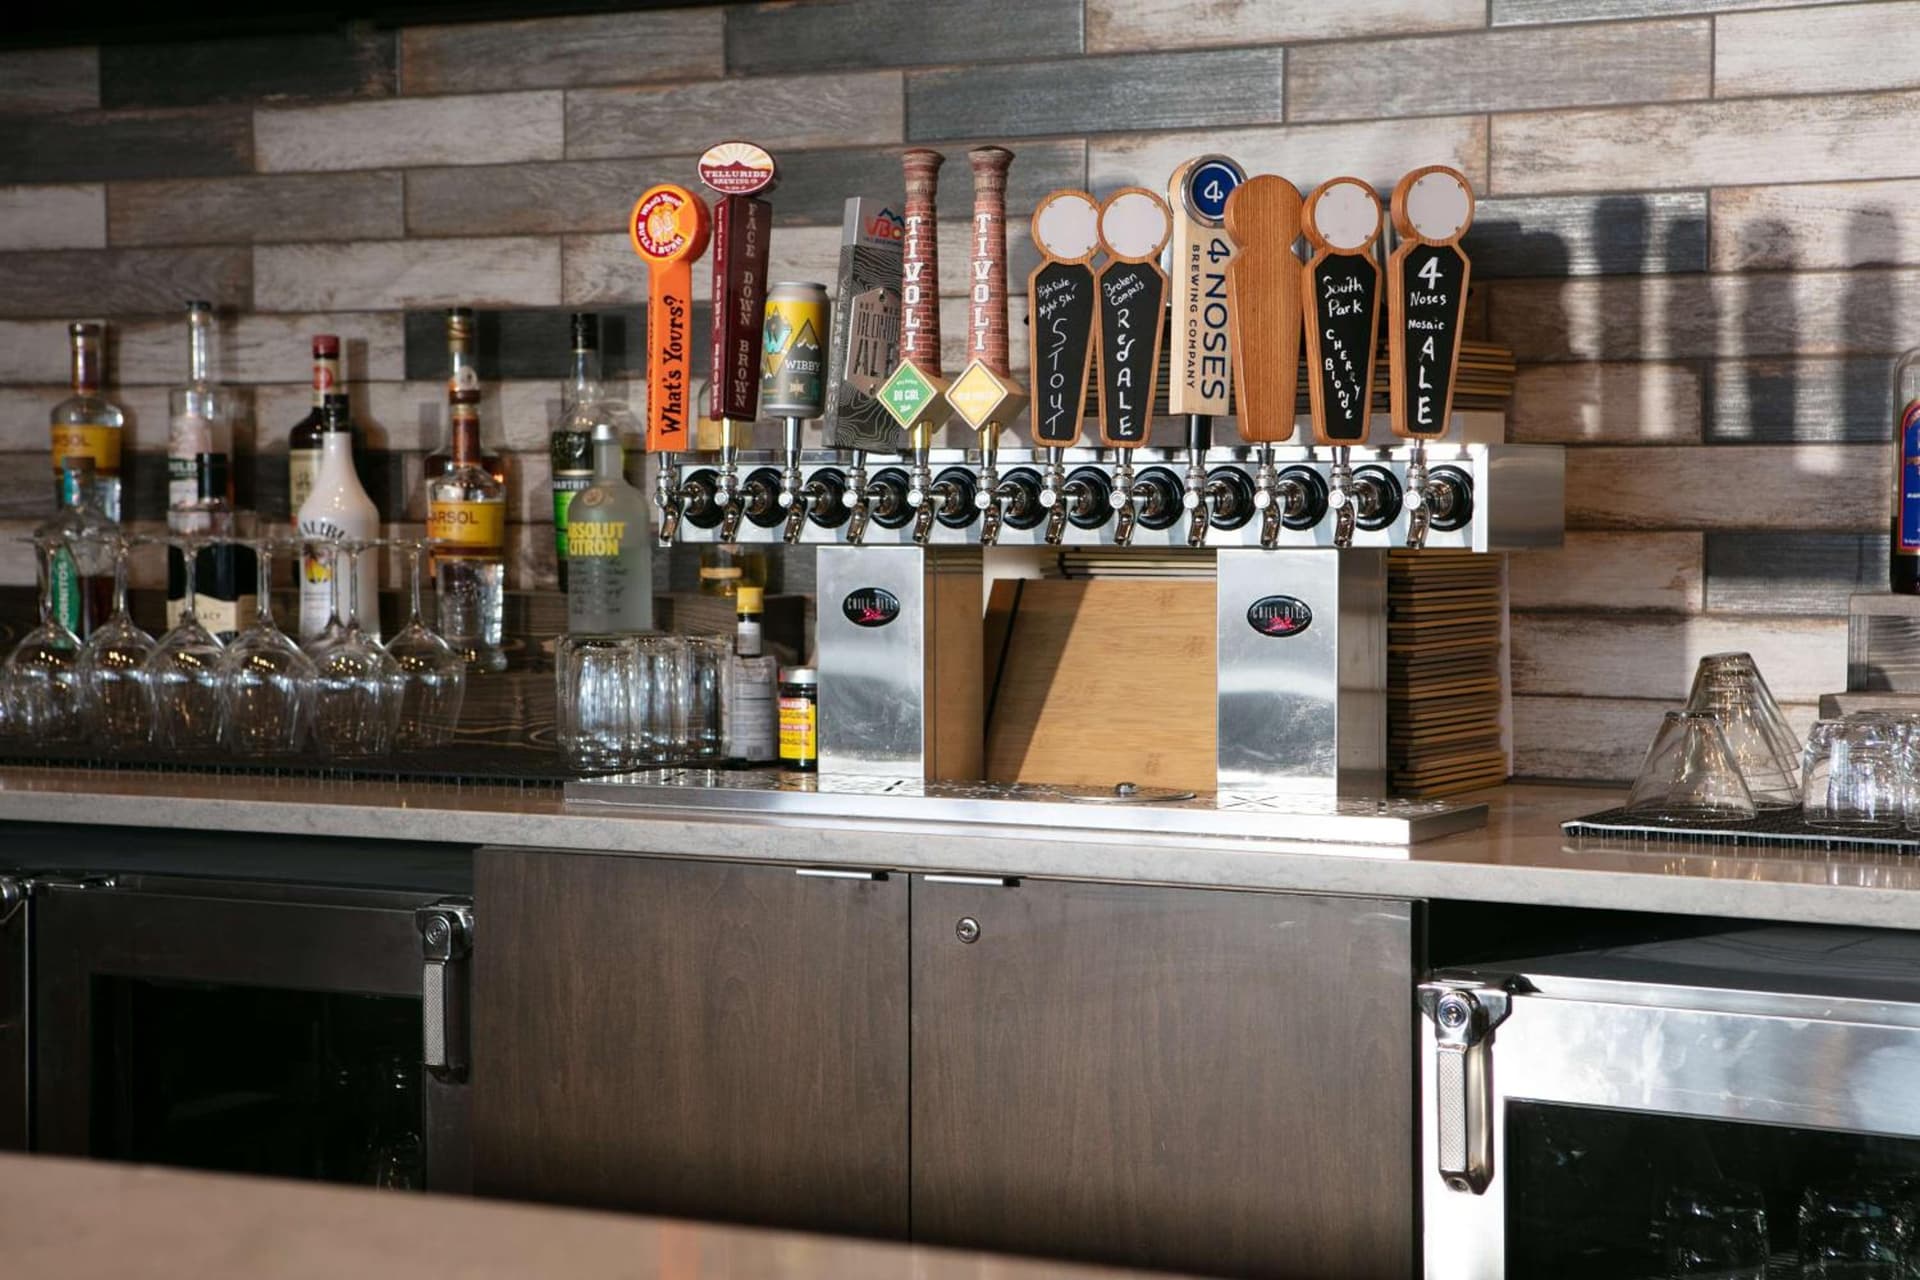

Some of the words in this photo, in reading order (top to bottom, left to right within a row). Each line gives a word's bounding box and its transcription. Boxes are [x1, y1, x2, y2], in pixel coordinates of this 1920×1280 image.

[703, 170, 769, 178] TELLURIDE
[1203, 179, 1225, 203] 4
[1189, 244, 1200, 314] BREWING
[1206, 237, 1231, 265] 4
[1417, 256, 1443, 290] 4
[740, 270, 755, 326] DOWN
[904, 215, 924, 352] TIVOLI
[972, 213, 994, 351] TIVOLI
[1103, 273, 1138, 297] Broken
[1111, 281, 1145, 306] Compass
[1323, 275, 1364, 299] South
[1328, 299, 1363, 318] Park
[1409, 291, 1447, 306] Noses
[663, 294, 684, 367] Yours?
[1201, 273, 1229, 400] NOSES
[1408, 318, 1446, 331] Mosaic
[734, 339, 750, 408] BROWN
[785, 359, 820, 371] WIBBY
[1045, 317, 1068, 436] STOUT
[1186, 319, 1198, 390] COMPANY
[1417, 336, 1435, 424] ALE
[661, 369, 682, 435] What's
[1117, 368, 1133, 436] ALE
